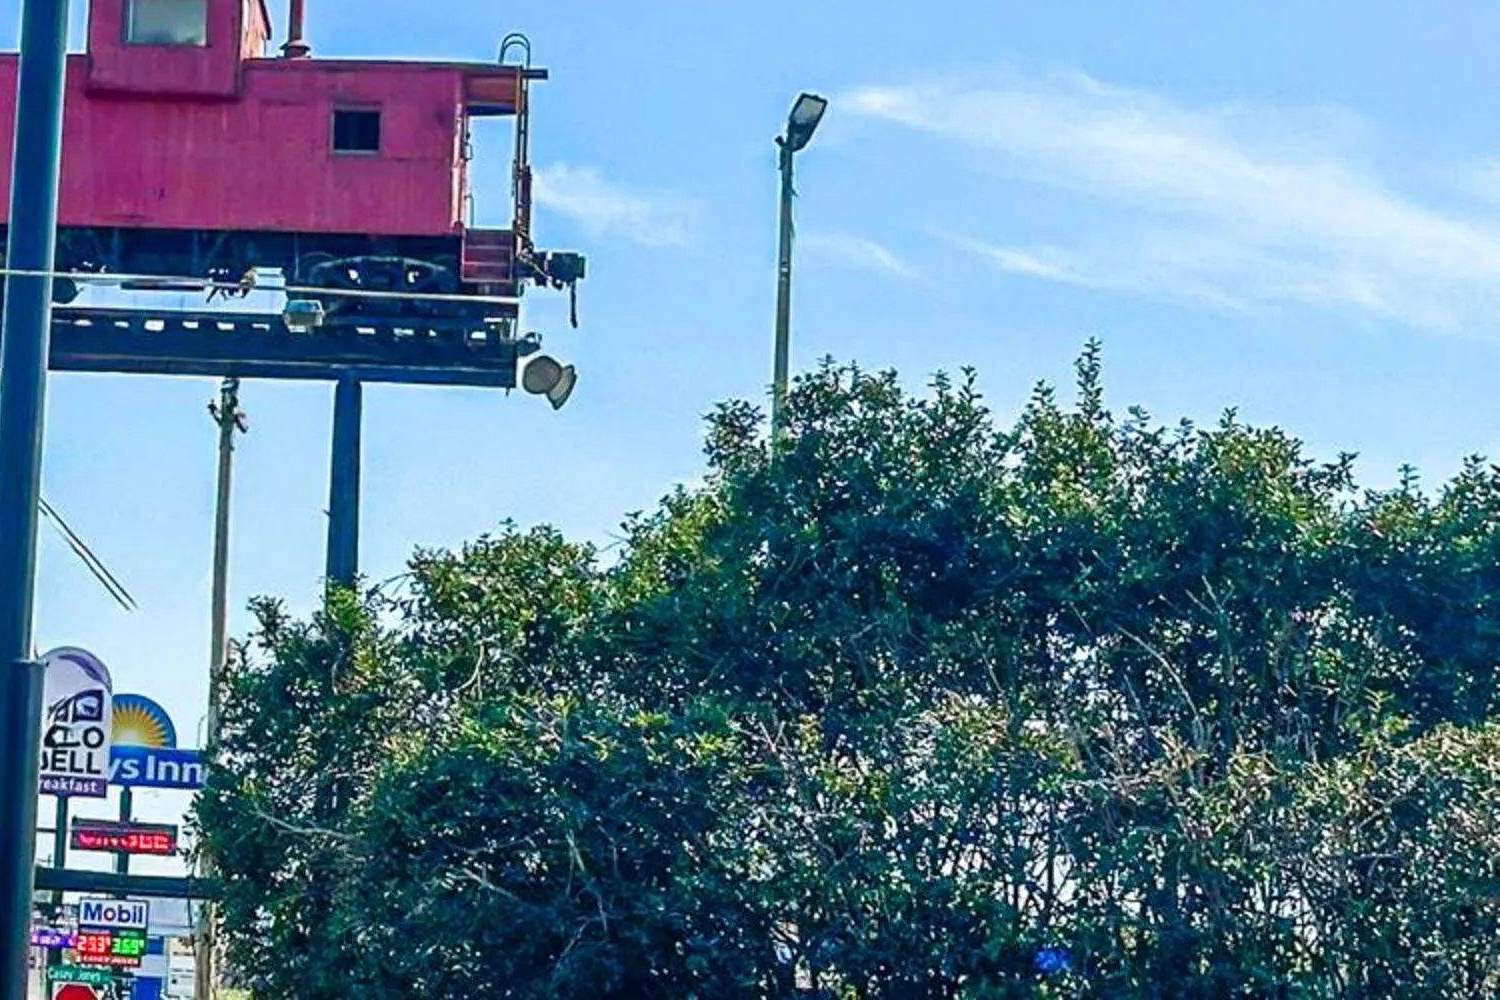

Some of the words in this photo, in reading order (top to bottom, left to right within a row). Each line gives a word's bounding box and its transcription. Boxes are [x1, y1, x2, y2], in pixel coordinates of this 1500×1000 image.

[145, 754, 203, 784] Inn
[38, 777, 99, 793] reakfast
[83, 901, 143, 924] Mobil
